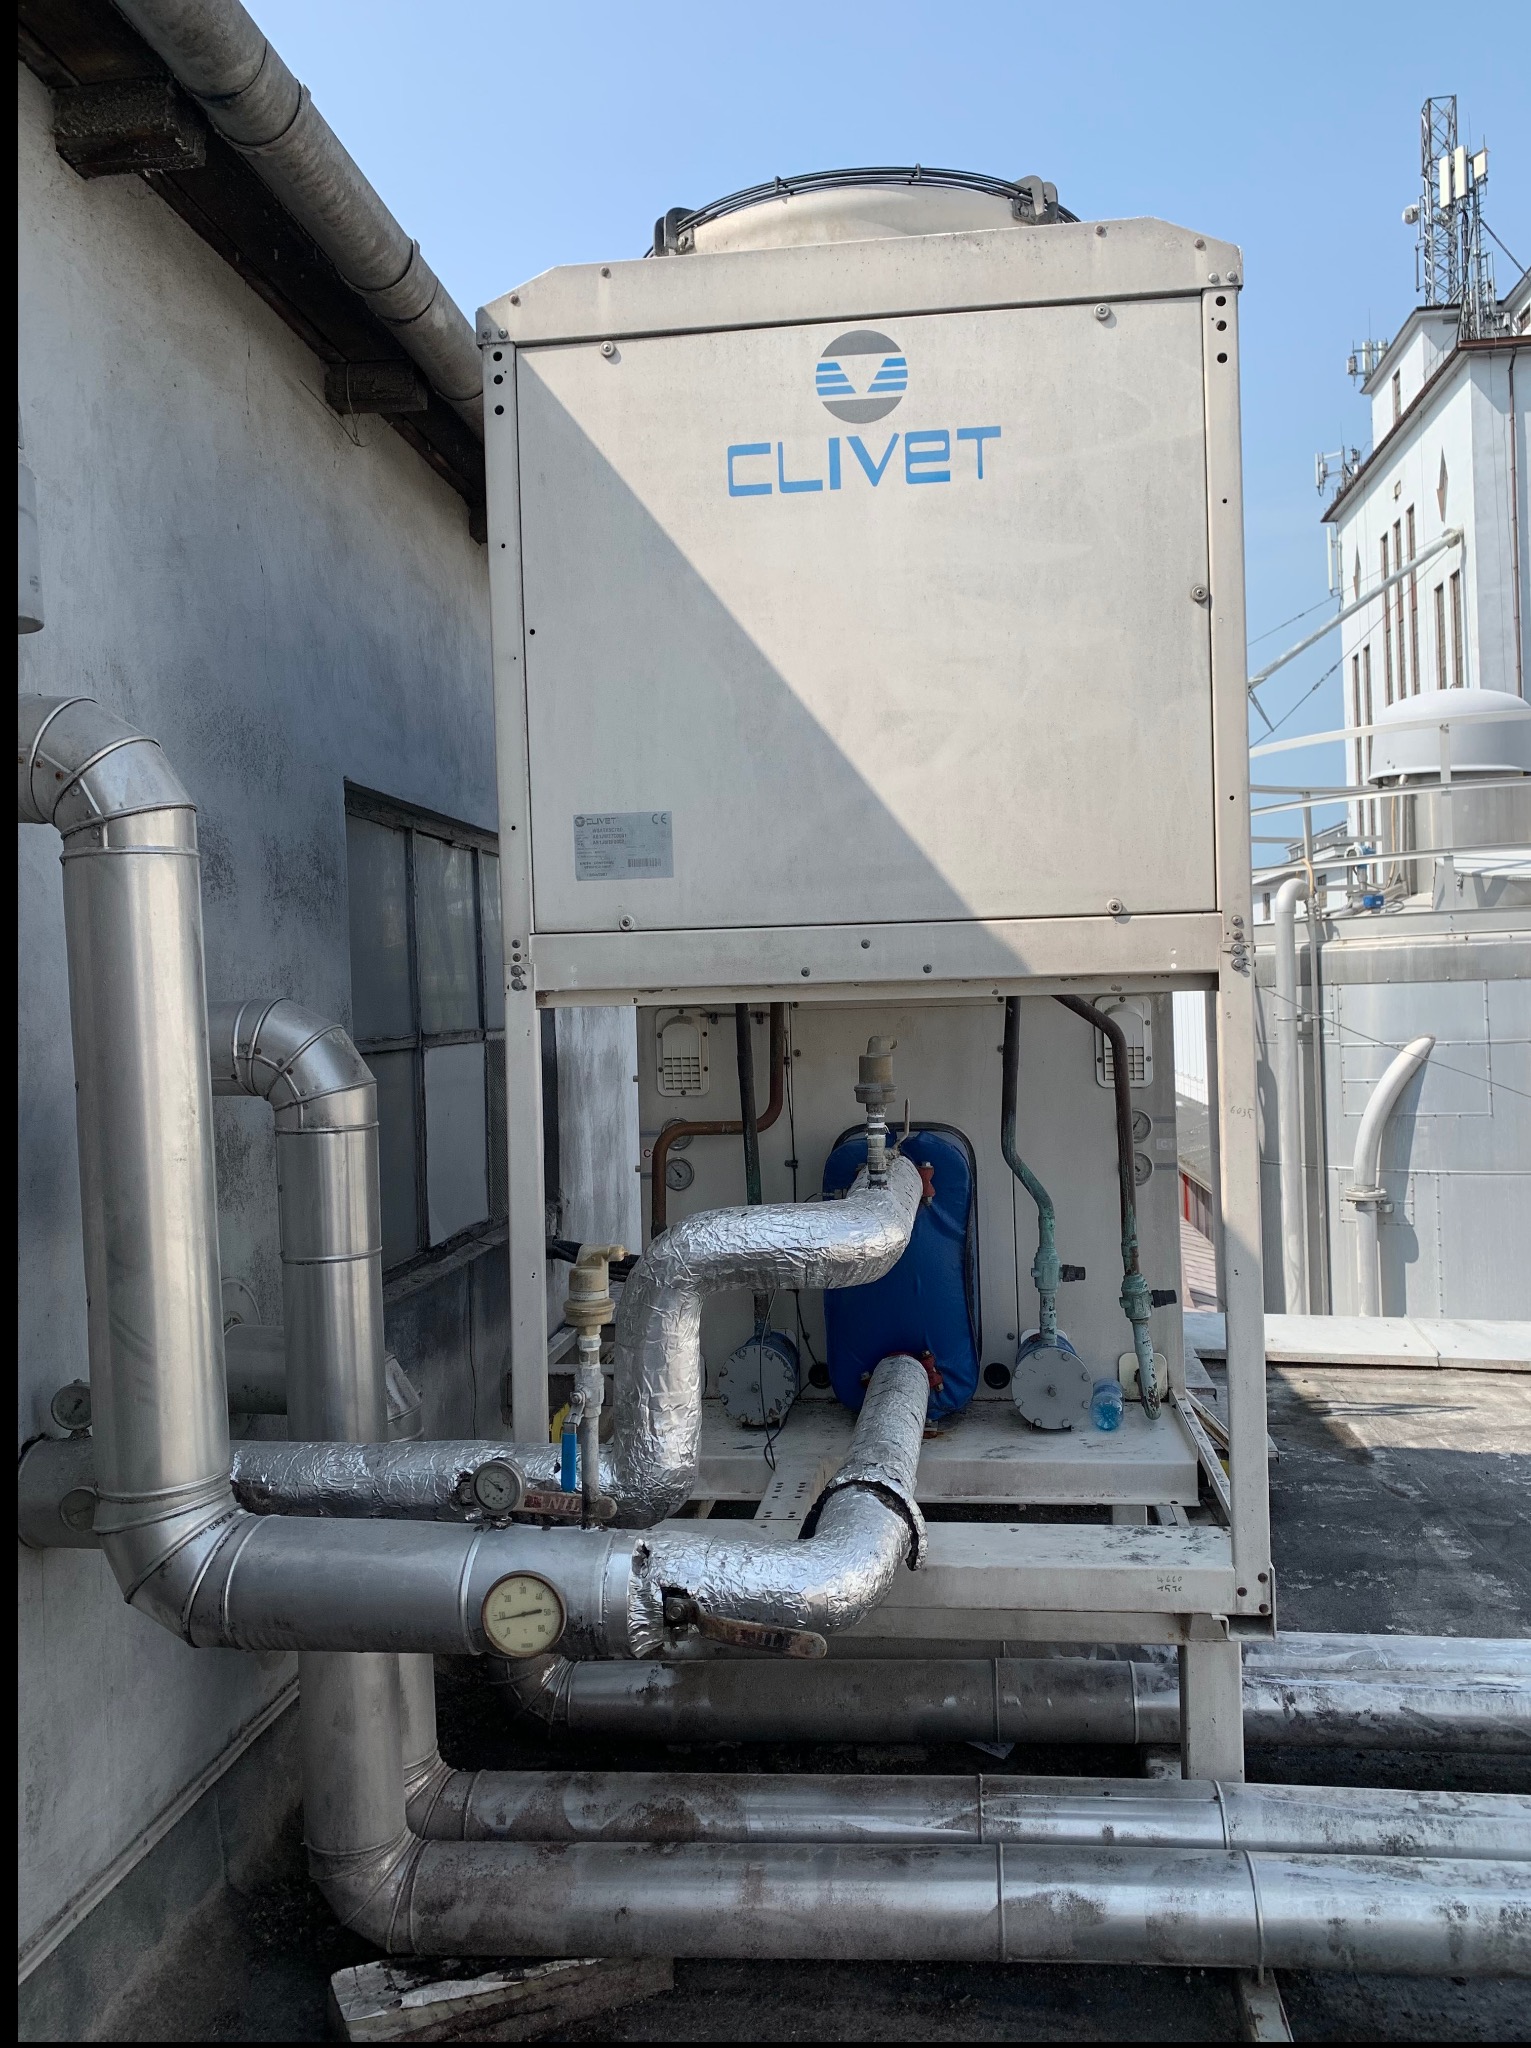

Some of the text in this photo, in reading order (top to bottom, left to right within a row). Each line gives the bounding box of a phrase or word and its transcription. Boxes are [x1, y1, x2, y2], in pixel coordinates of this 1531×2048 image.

[520, 1586, 527, 1595] 30
[504, 1595, 511, 1603] 20
[535, 1592, 542, 1601] 40
[544, 1608, 551, 1616] 50
